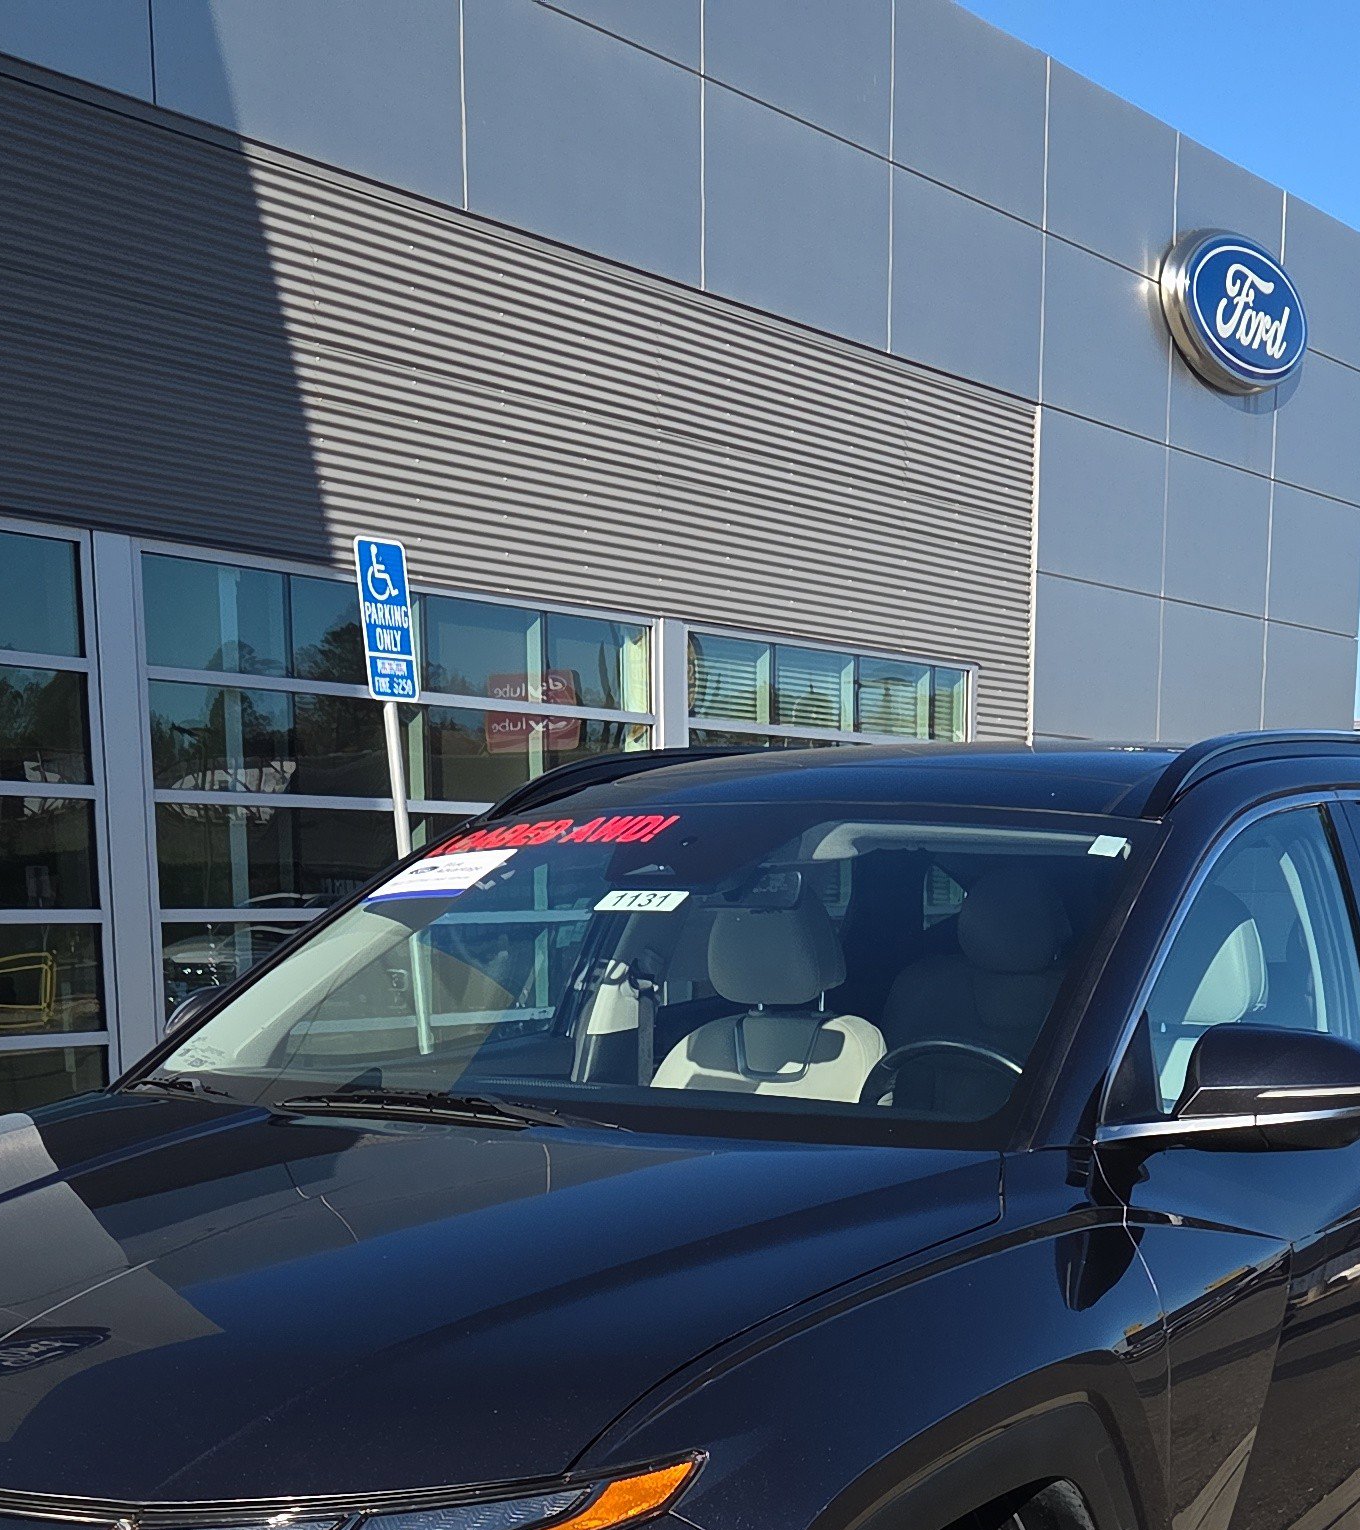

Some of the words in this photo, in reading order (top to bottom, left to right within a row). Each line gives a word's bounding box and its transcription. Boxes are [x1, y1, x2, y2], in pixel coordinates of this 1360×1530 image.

[1216, 263, 1290, 359] Ford
[365, 601, 409, 629] PARKING
[376, 628, 402, 652] ONLY
[374, 676, 392, 694] FINE
[394, 678, 413, 695] $250
[558, 815, 681, 843] AWD!
[612, 893, 672, 908] 1131
